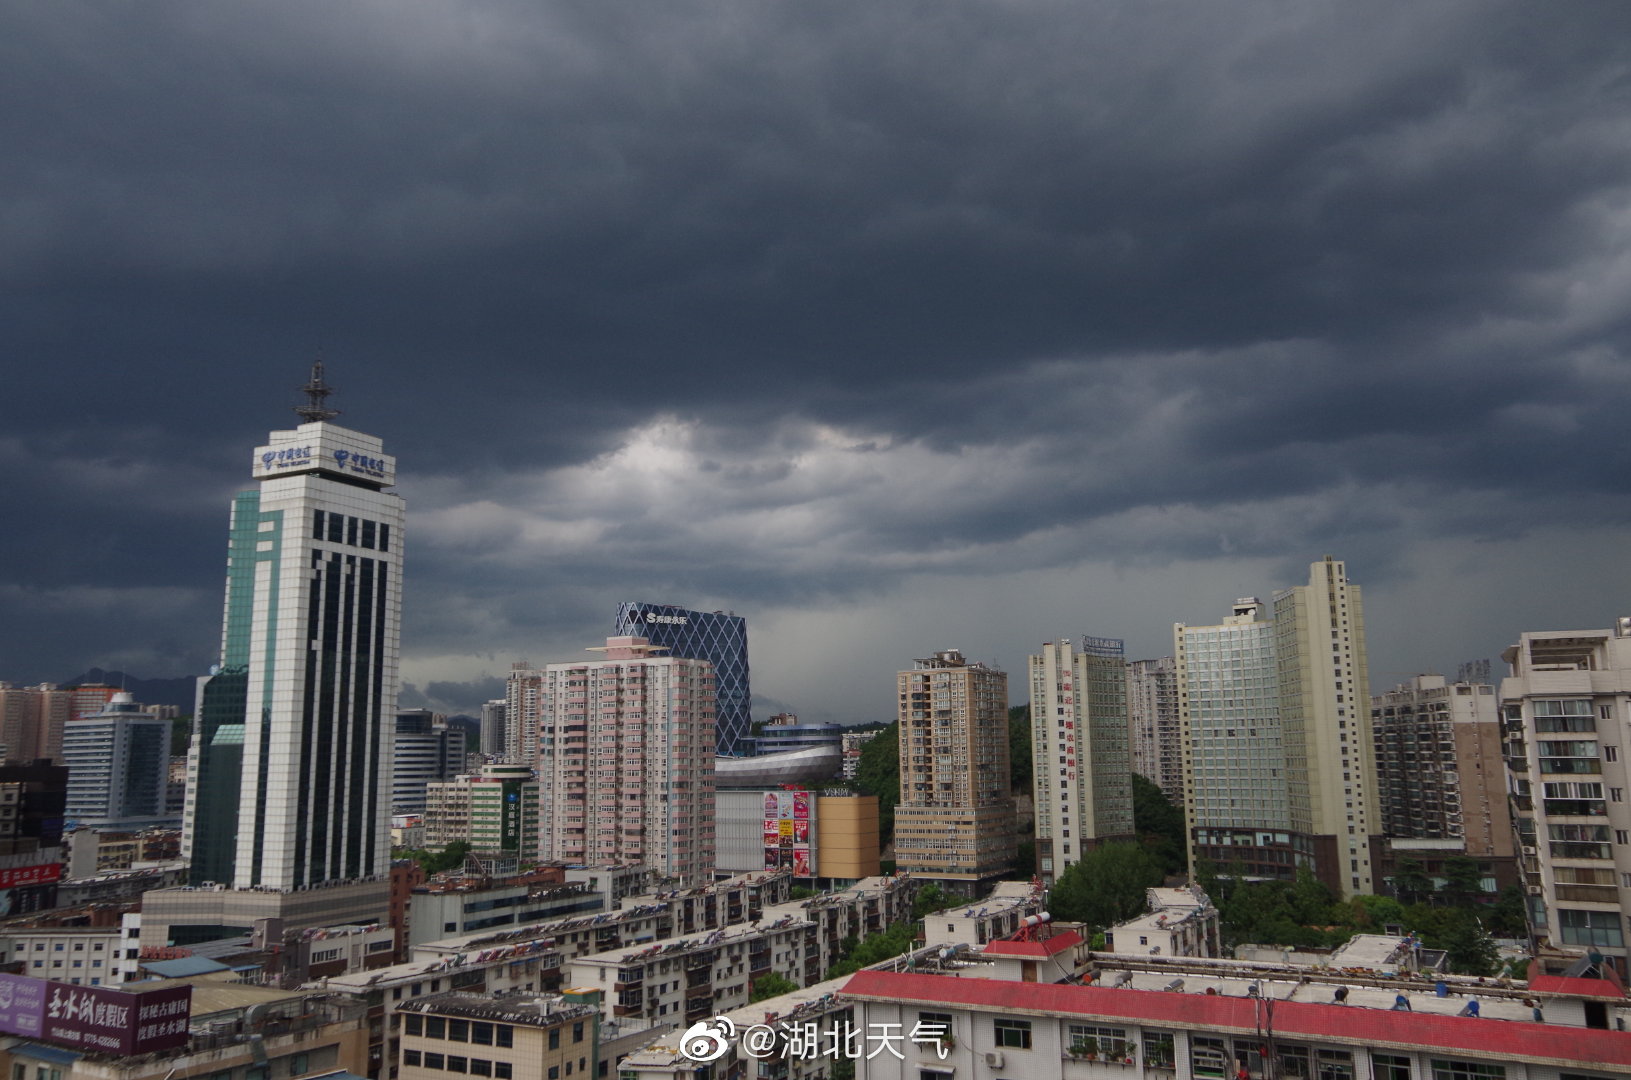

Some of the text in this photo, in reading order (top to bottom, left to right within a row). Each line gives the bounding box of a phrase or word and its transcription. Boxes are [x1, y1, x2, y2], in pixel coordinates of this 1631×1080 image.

[278, 445, 311, 463] 中国电信
[352, 452, 384, 472] 中国电信
